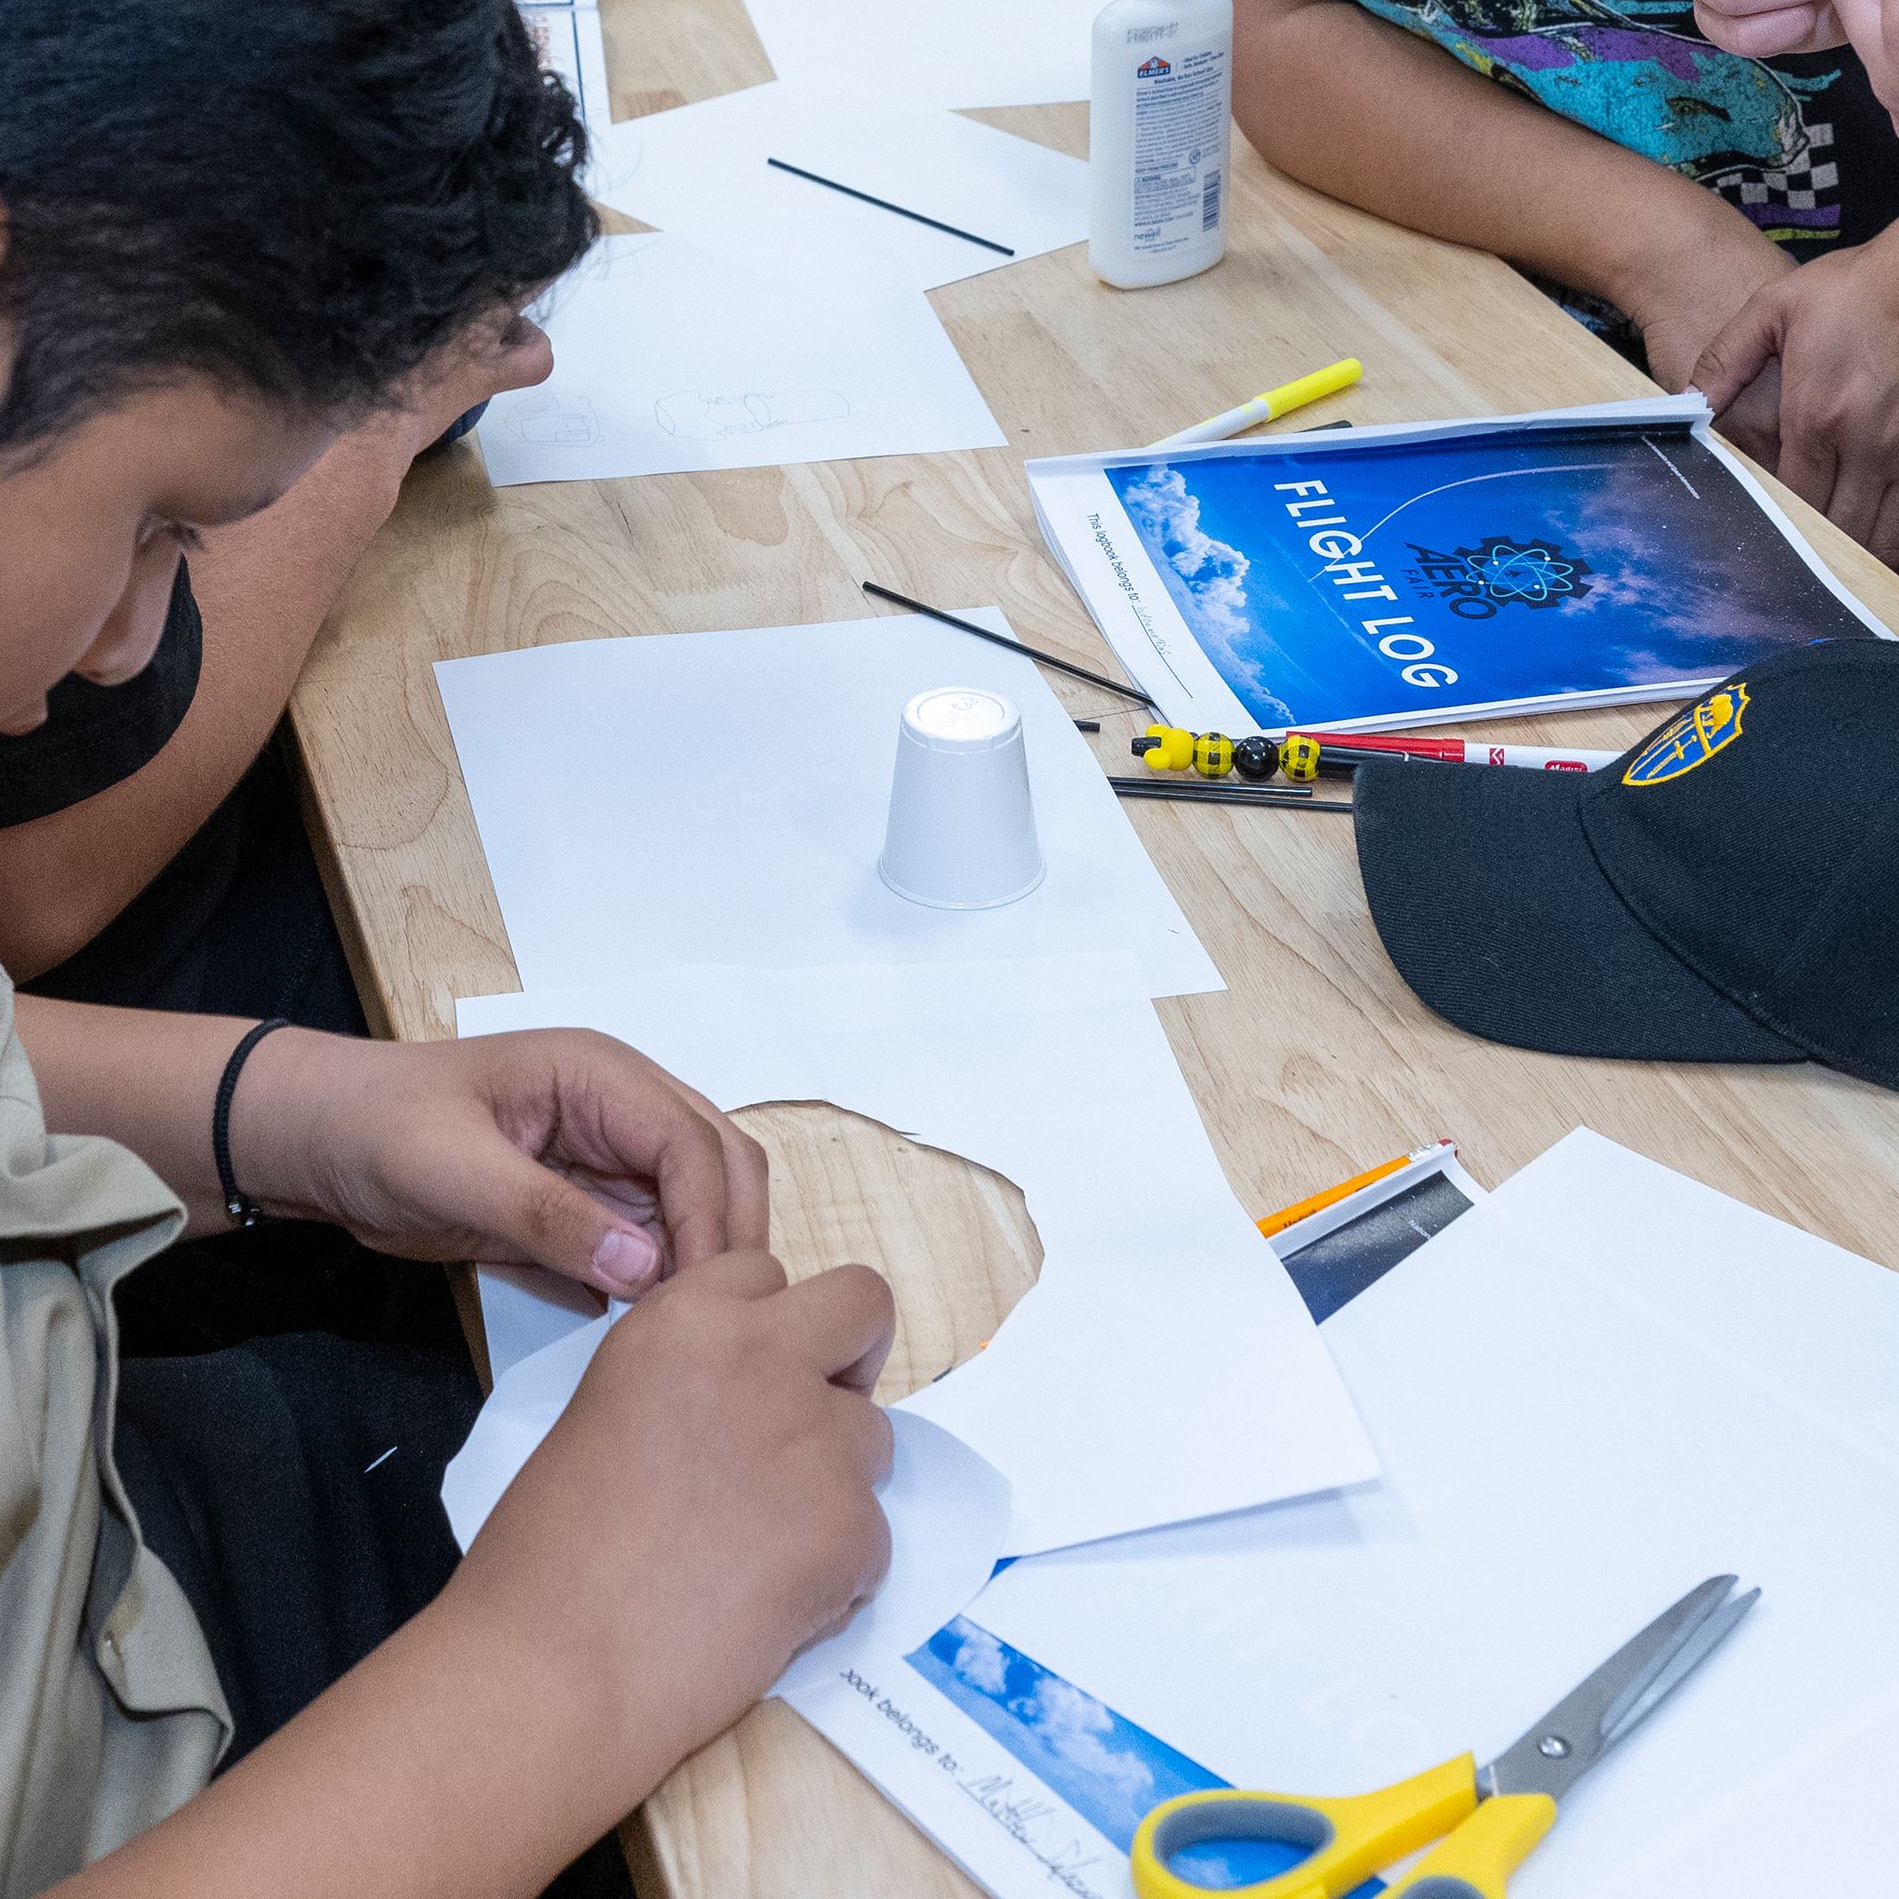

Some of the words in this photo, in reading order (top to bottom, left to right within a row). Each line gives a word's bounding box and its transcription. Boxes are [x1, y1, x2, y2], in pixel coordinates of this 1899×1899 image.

[1087, 512, 1101, 531] This
[1095, 529, 1119, 562] logbook
[1111, 558, 1135, 593] belongs
[1273, 480, 1398, 601] FLIGHT
[1361, 616, 1459, 688] LOG
[1402, 568, 1435, 599] FAIR
[1404, 541, 1497, 620] AERO
[877, 1698, 939, 1755] belongs
[938, 1753, 964, 1777] to:
